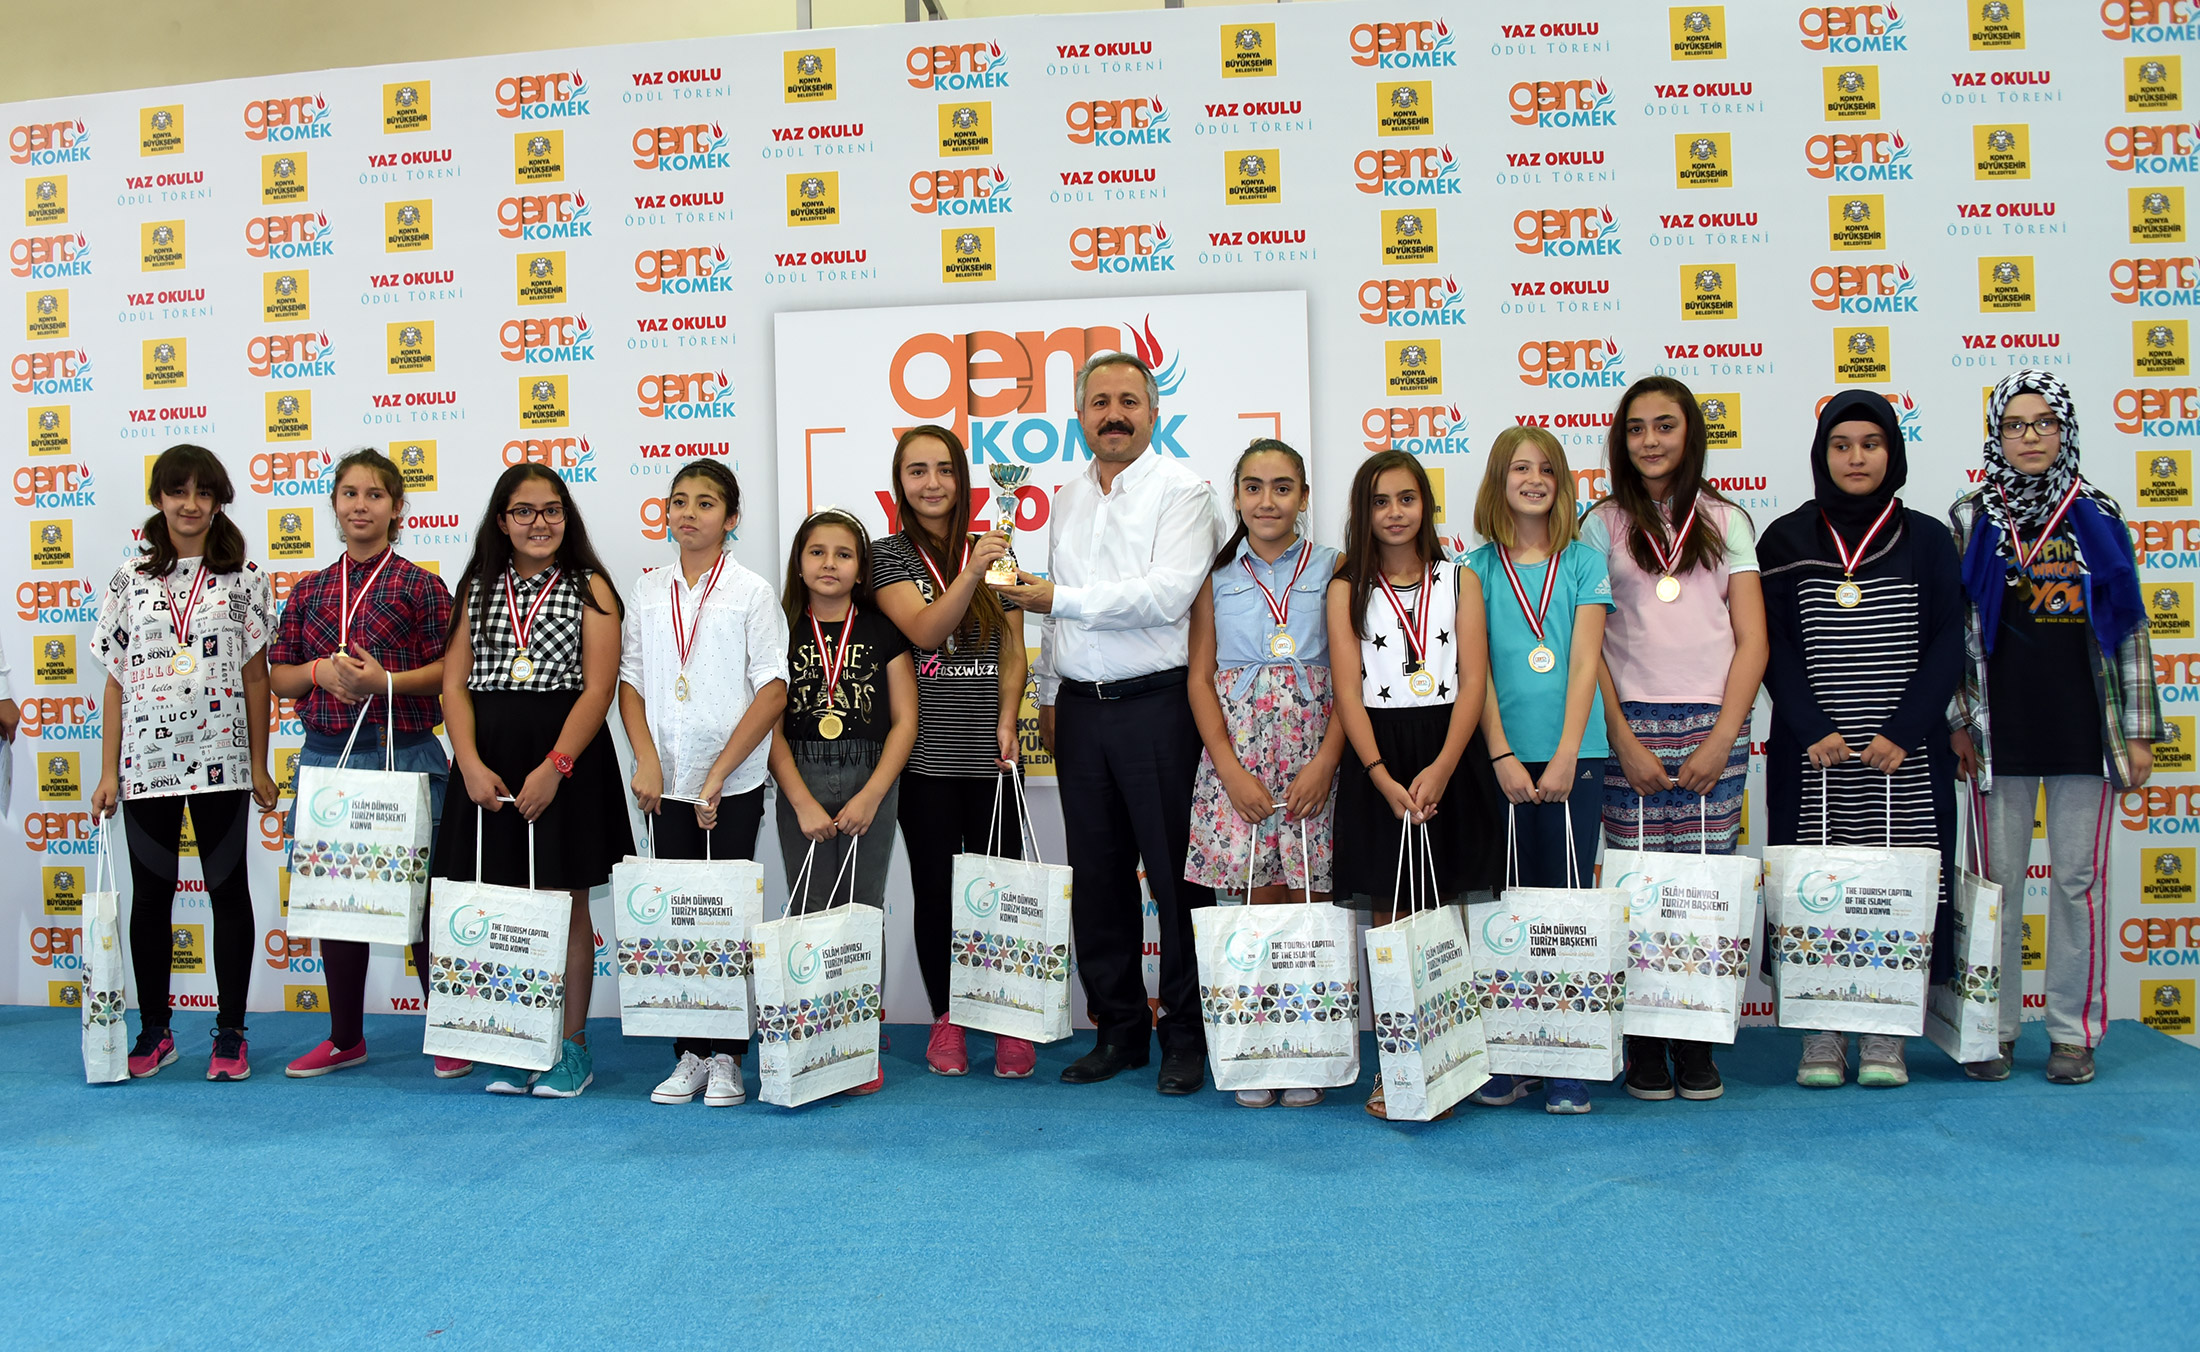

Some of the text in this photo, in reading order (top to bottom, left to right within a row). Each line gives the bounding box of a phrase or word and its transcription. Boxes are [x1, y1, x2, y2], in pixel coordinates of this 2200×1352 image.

[1675, 42, 1722, 50] BÜYÜKŞEHİR
[1226, 59, 1272, 67] BÜYÜKŞEHİR
[1380, 49, 1456, 69] KOMEK
[788, 84, 832, 93] BÜYÜKŞEHİR
[1206, 101, 1301, 117] YAZ OKULU
[773, 124, 863, 141] YAZ OKULU
[1195, 120, 1312, 135] ÖDÜL TÖRENİ
[32, 147, 90, 165] KOMEK
[762, 142, 873, 158] ÖDÜL TÖRENİ
[1836, 162, 1912, 181] KOMEK
[127, 171, 203, 189] YAZ OKULU
[118, 191, 211, 204] ÖDÜL TÖRENİ
[938, 197, 1012, 216] KOMEK
[1958, 203, 2055, 217] YAZ OKULU
[1840, 225, 1869, 233] KONYA
[1947, 223, 2066, 236] ÖDÜL TÖRENİ
[1834, 232, 1881, 240] BÜYÜKŞEHİR
[1392, 239, 1421, 247] KONYA
[1386, 246, 1433, 254] BÜYÜKŞEHİR
[371, 271, 453, 287] YAZ OKULU
[361, 288, 462, 304] ÖDÜL TÖRENİ
[391, 356, 431, 364] BÜYÜKŞEHİR
[526, 346, 594, 363] KOMEK
[34, 377, 93, 394] KOMEK
[665, 401, 735, 419] KOMEK
[130, 666, 174, 683] HELLO
[160, 710, 197, 723] LUCY
[43, 720, 102, 740] KOMEK
[42, 784, 78, 792] BÜYÜKŞEHİR
[1662, 885, 1719, 900] İSLÂM DÜNYASI
[1845, 887, 1913, 898] THE TOURISM CAPITAL
[2144, 884, 2192, 894] BÜYÜKŞEHİR
[671, 894, 723, 906] İSLÂM DÜNYASI
[1662, 897, 1729, 912] TURİZM BAŞKENTİ
[1845, 896, 1892, 906] OF THE ISLAMIC
[671, 906, 733, 918] TURİZM BAŞKENTİ
[1845, 906, 1868, 915] WORLD
[1869, 907, 1891, 916] KONYA
[492, 922, 550, 939] THE TOURISM CAPITAL
[1529, 922, 1587, 935] İSLÂM DÜNYASI
[490, 932, 531, 945] OF THE ISLAMIC
[1271, 940, 1335, 950] THE TOURISM CAPITAL
[1530, 935, 1598, 948] TURİZM BAŞKENTİ
[490, 941, 509, 951] WORLD
[1530, 947, 1556, 957] KONYA
[1271, 950, 1316, 960] OF THE ISLAMIC
[1272, 961, 1294, 970] WORLD
[1295, 960, 1316, 969] KONYA
